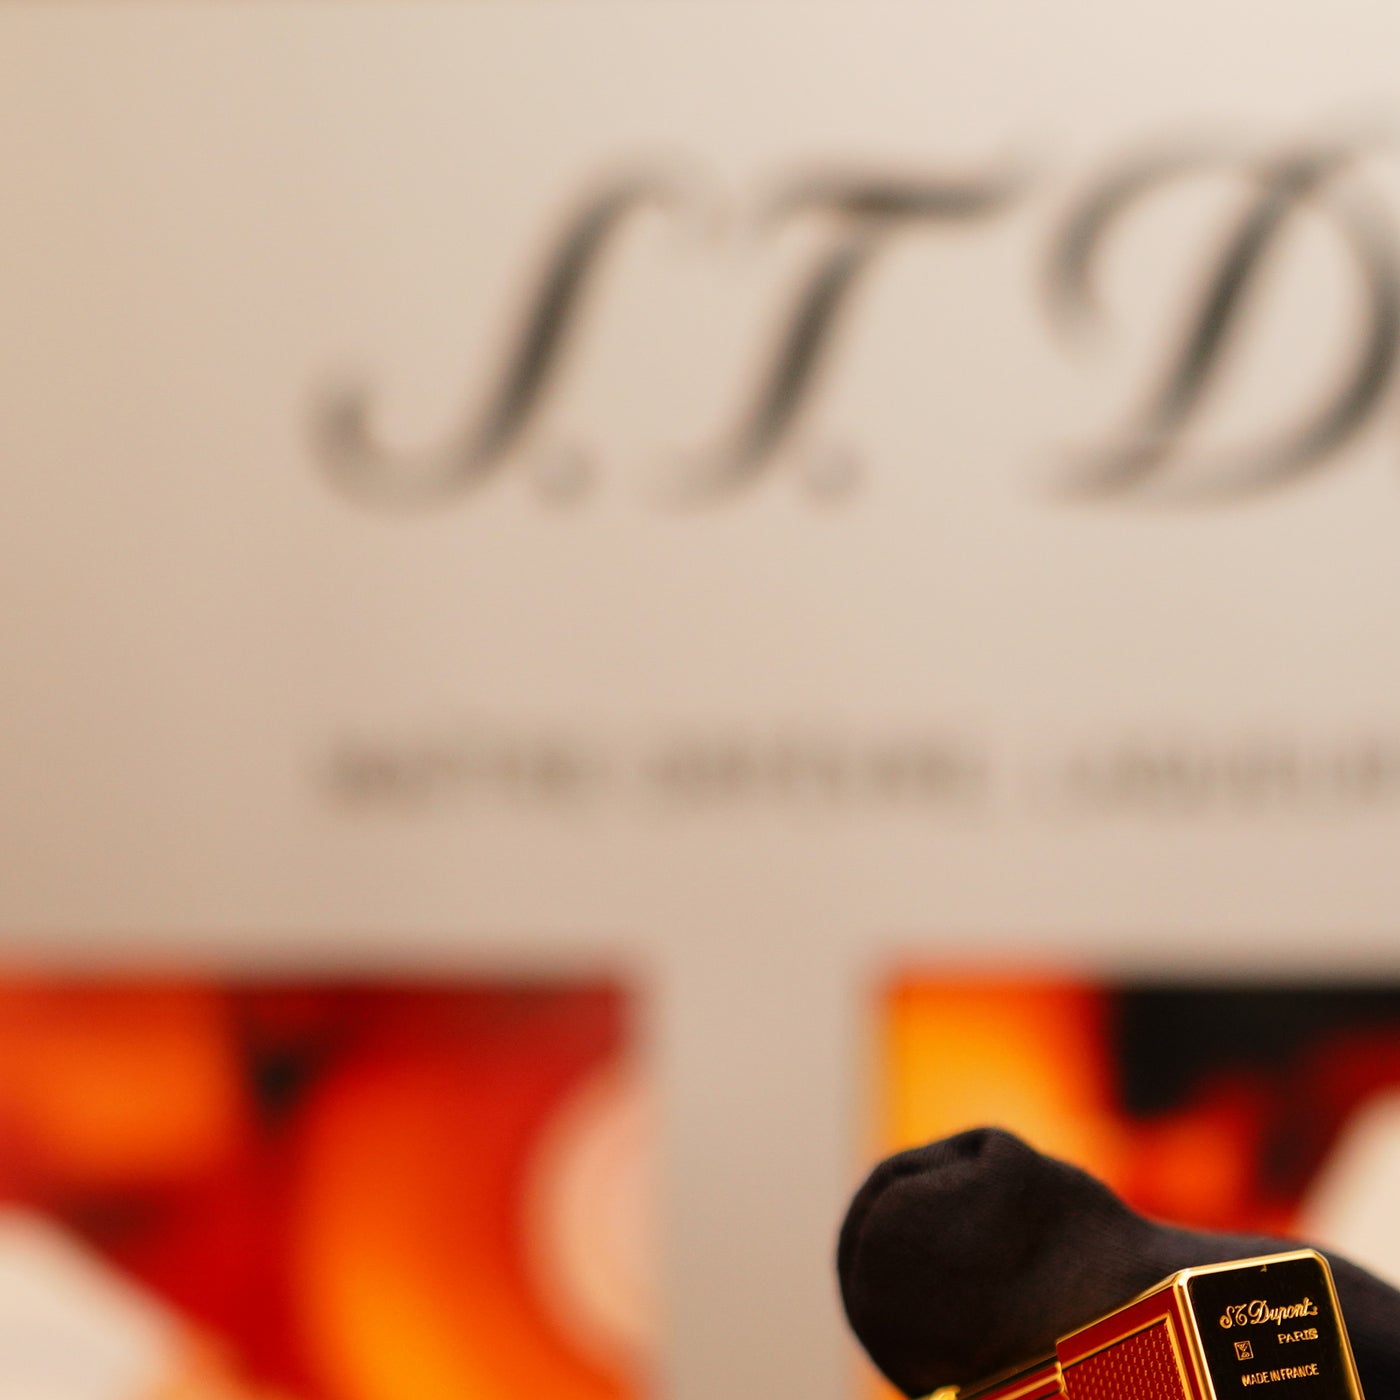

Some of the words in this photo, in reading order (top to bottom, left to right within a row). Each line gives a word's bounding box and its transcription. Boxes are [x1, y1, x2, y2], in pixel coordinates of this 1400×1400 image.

[1248, 1297, 1318, 1325] Dupont
[1277, 1328, 1319, 1344] PARIS
[1241, 1371, 1270, 1387] MADE
[1270, 1369, 1281, 1382] IN
[1280, 1363, 1320, 1380] FRANCE
